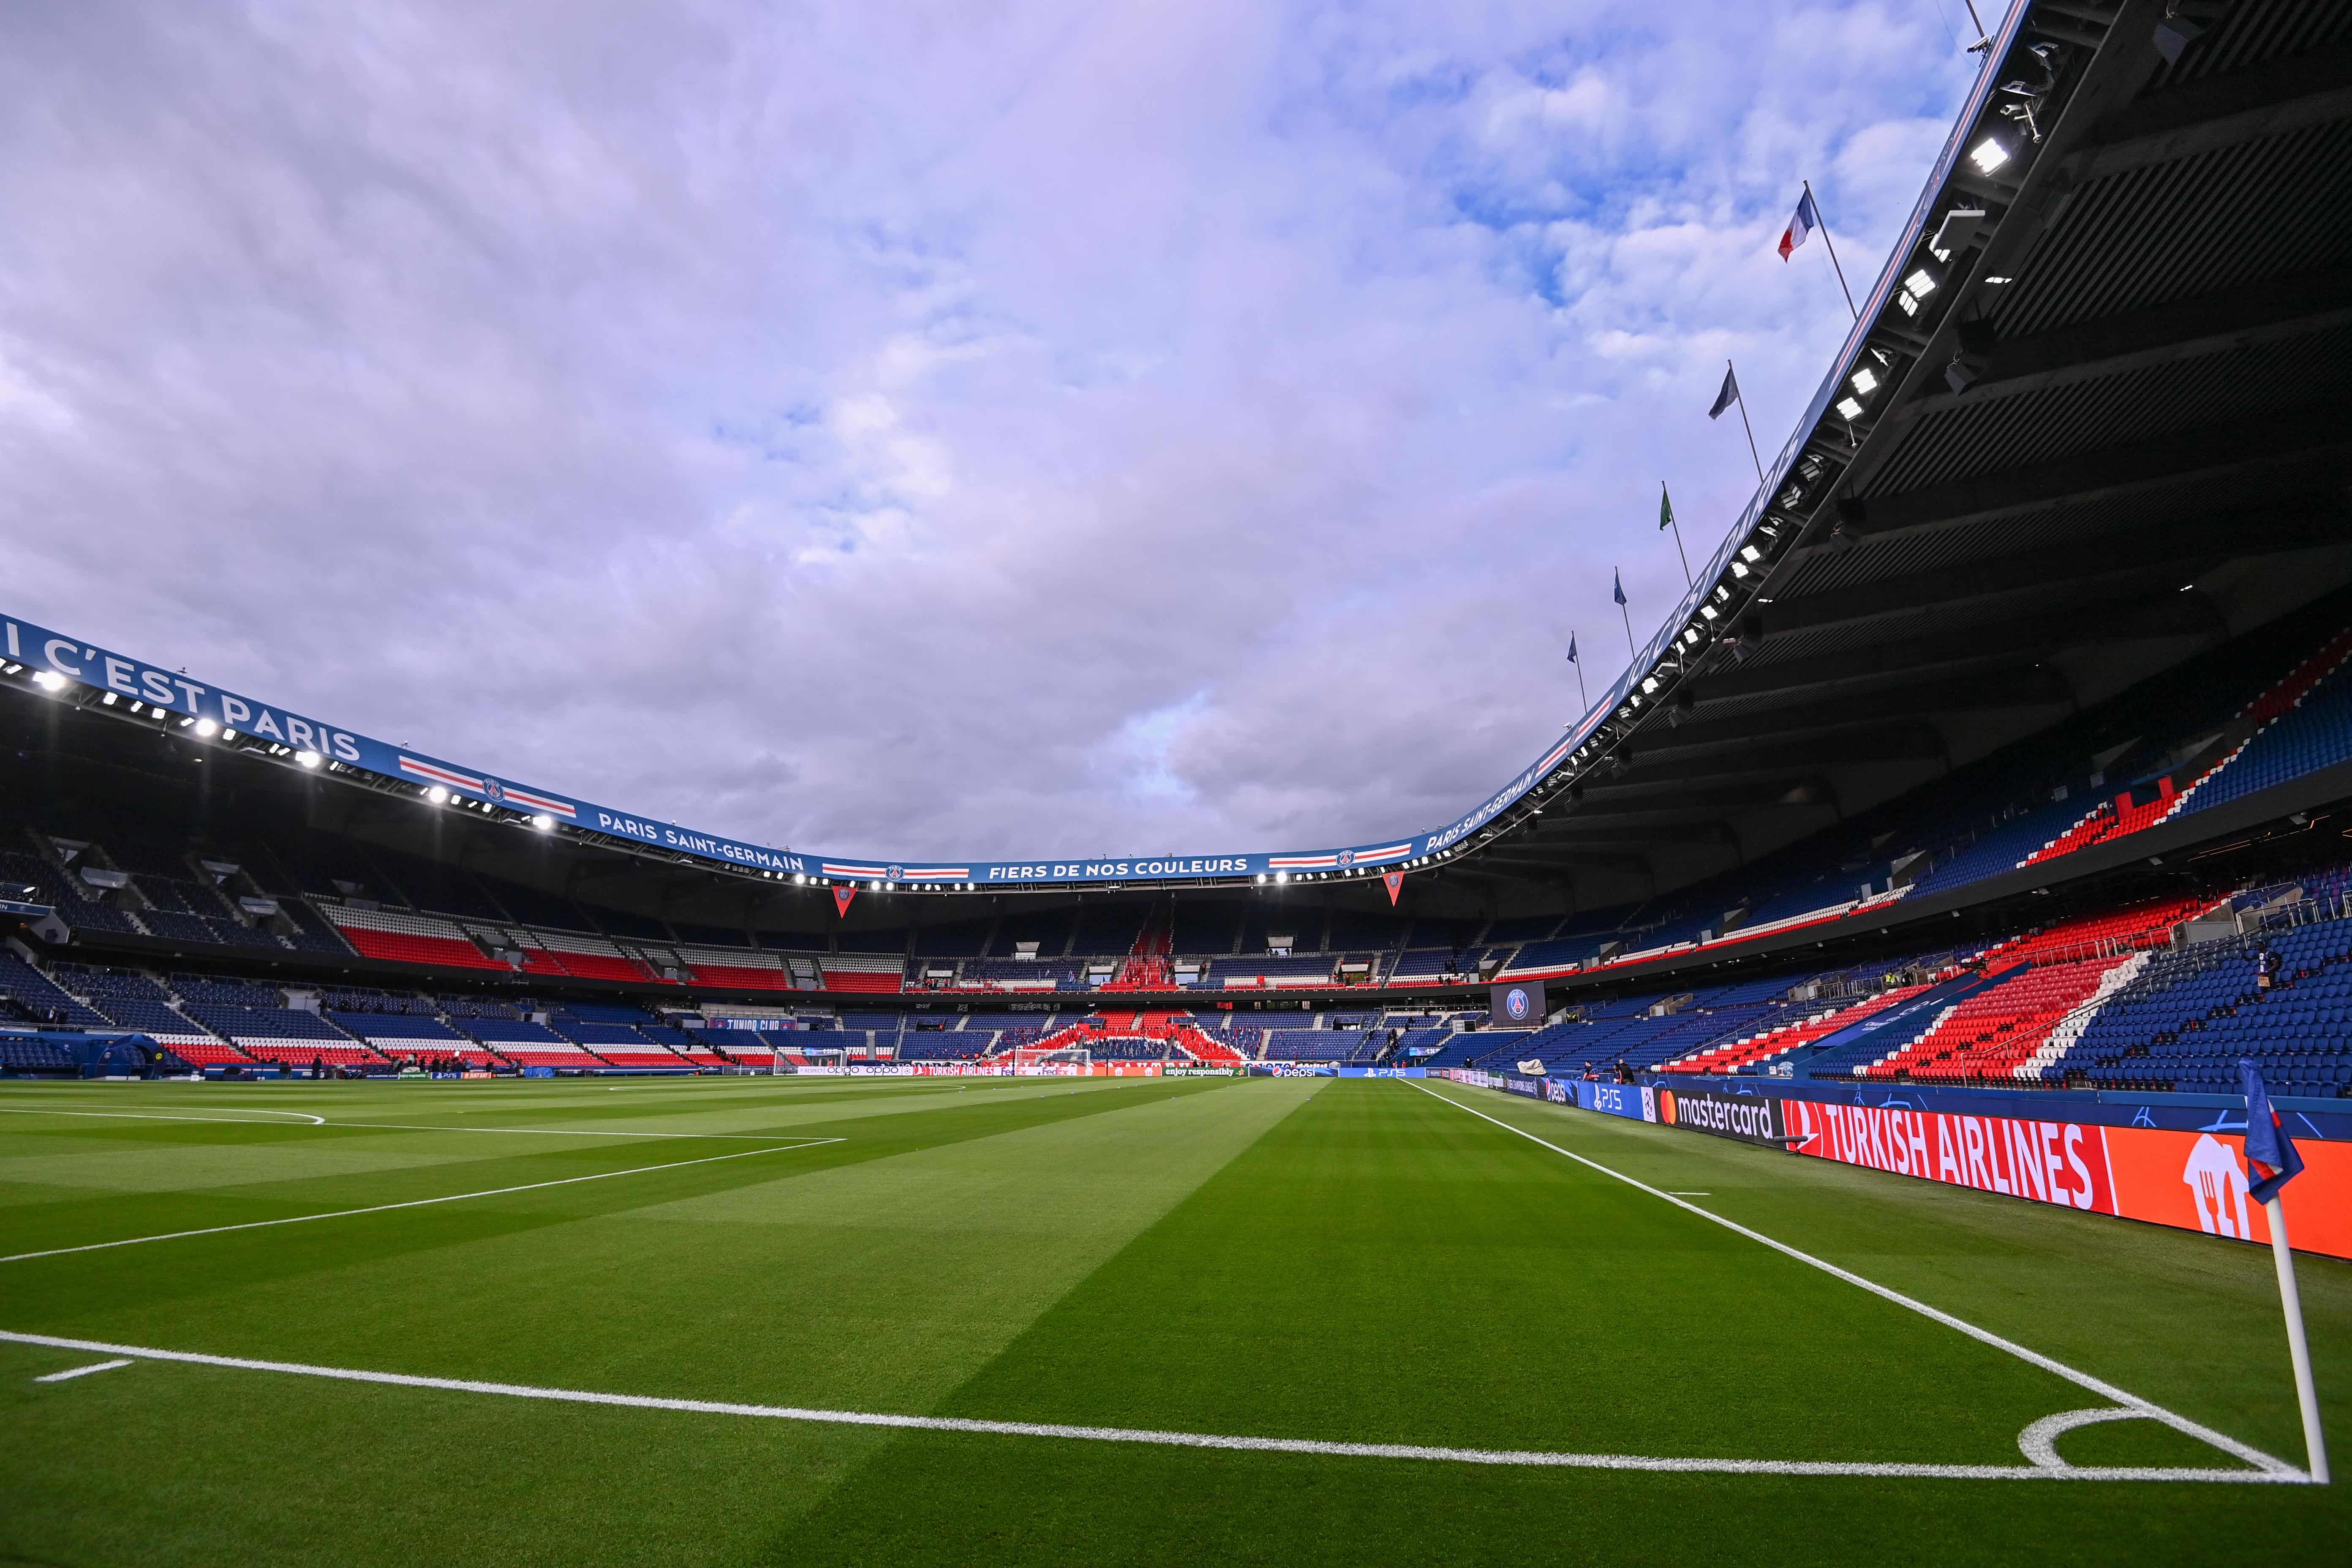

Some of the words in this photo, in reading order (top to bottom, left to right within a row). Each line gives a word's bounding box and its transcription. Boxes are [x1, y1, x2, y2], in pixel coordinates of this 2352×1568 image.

[1714, 415, 1807, 579] PARIS
[44, 639, 205, 714] C'EST
[222, 694, 360, 761] PARIS
[1426, 829, 1459, 852] PARIS
[1461, 768, 1535, 833] SAINT-GERMAIN
[598, 813, 657, 839] PARIS
[666, 830, 804, 871] SAINT-GERMAIN
[989, 866, 1048, 879] FIERS
[1053, 864, 1080, 877] DE
[1086, 863, 1129, 876] NOS
[1135, 858, 1248, 875] COULEURS
[726, 1019, 757, 1032] JUNIOR
[866, 1067, 898, 1075] oppo
[929, 1067, 959, 1075] TURKISH
[961, 1067, 993, 1075] AIRLINES
[1042, 1067, 1068, 1075] FedEx
[1165, 1068, 1187, 1076] enjoy
[1188, 1068, 1234, 1077] responsibly
[1284, 1068, 1315, 1077] pepsi
[1551, 1082, 1566, 1103] pepsi
[1601, 1088, 1622, 1110] PS5
[1677, 1093, 1773, 1140] mastercard
[1825, 1104, 1931, 1178] TURKISH
[1937, 1113, 2094, 1210] AIRLINES
